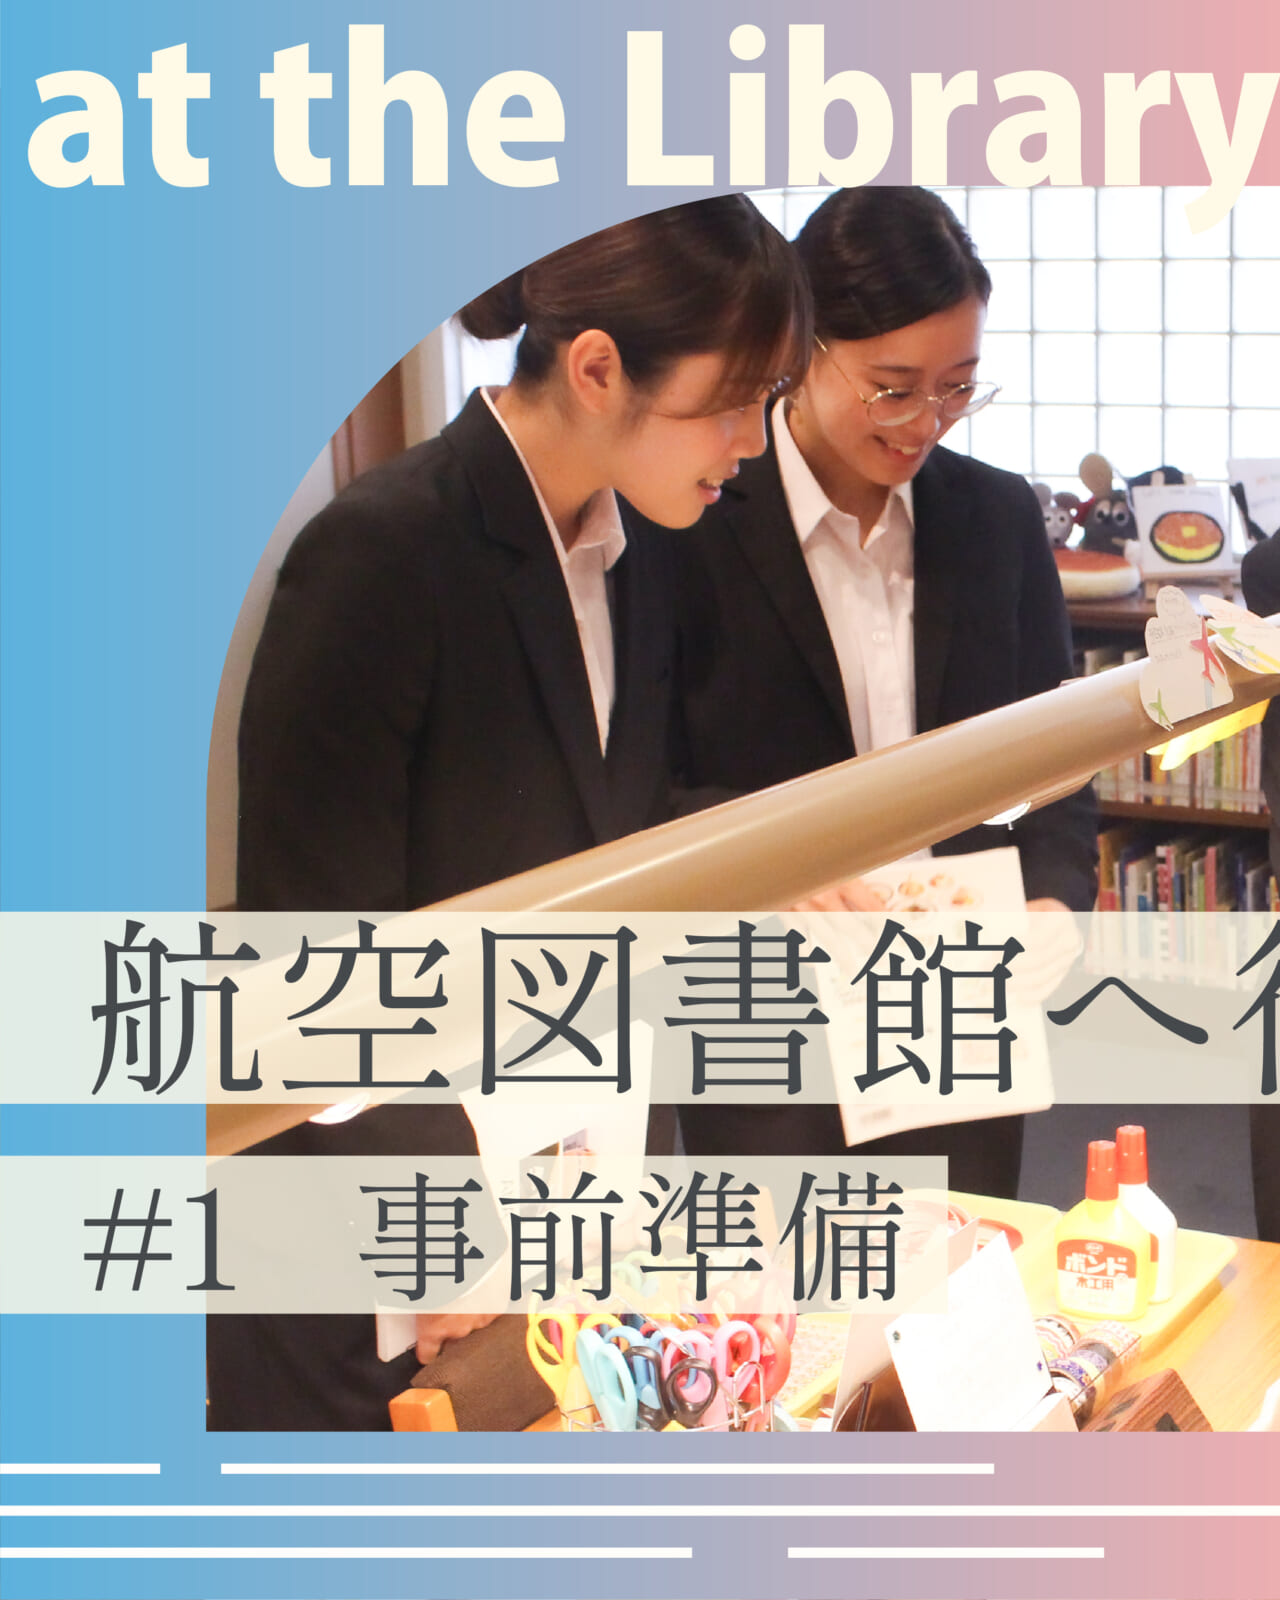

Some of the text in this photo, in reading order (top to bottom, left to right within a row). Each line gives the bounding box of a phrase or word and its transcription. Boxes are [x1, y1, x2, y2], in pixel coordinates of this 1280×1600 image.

[1065, 1252, 1128, 1276] ボンド
[1076, 1276, 1114, 1291] 木工用
